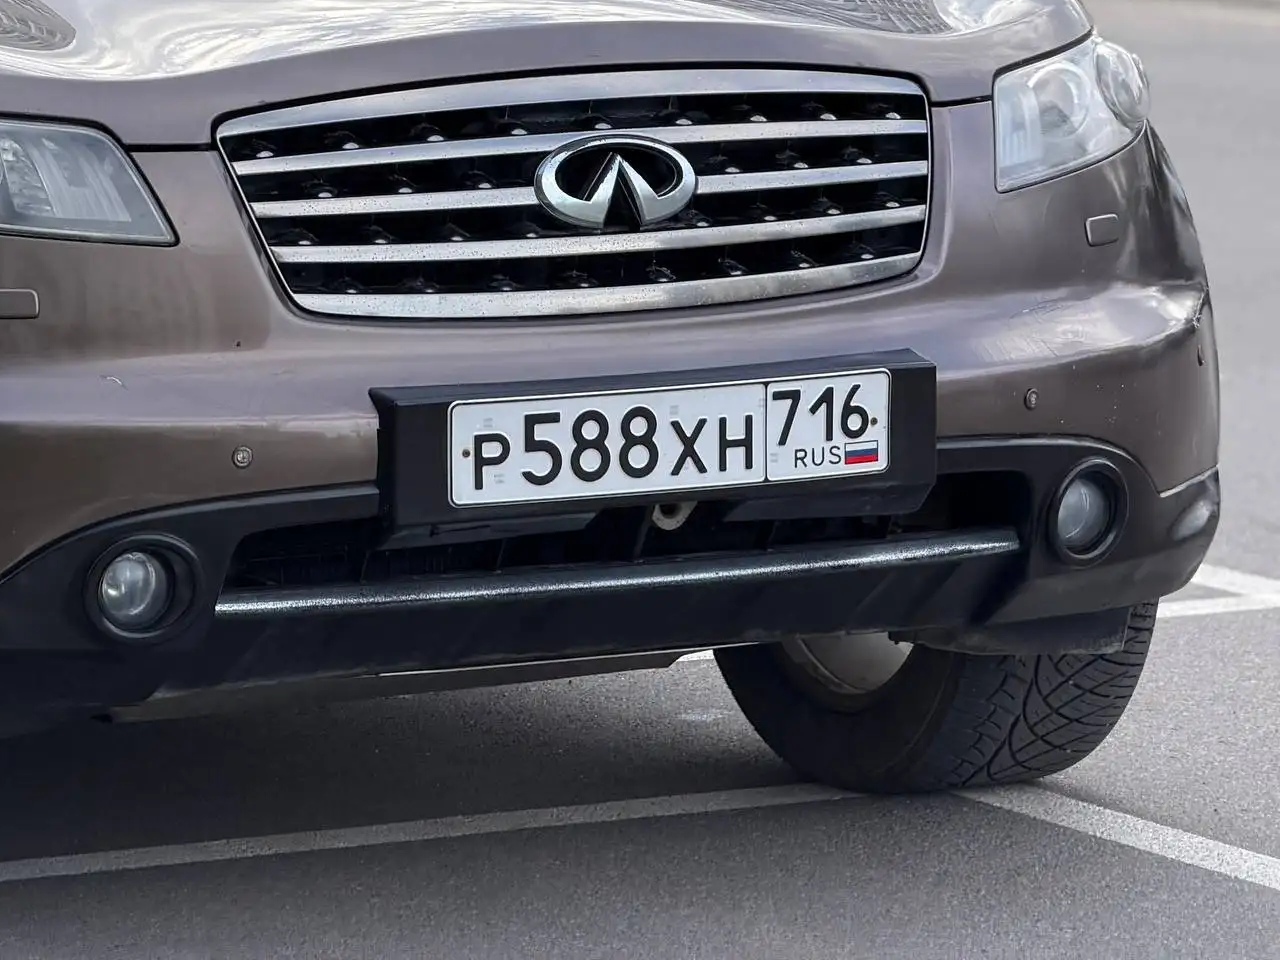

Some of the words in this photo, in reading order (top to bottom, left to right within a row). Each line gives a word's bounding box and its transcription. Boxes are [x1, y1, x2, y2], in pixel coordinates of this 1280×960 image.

[473, 406, 754, 491] Р588ХН
[772, 383, 870, 447] 716
[794, 445, 842, 469] RUS
